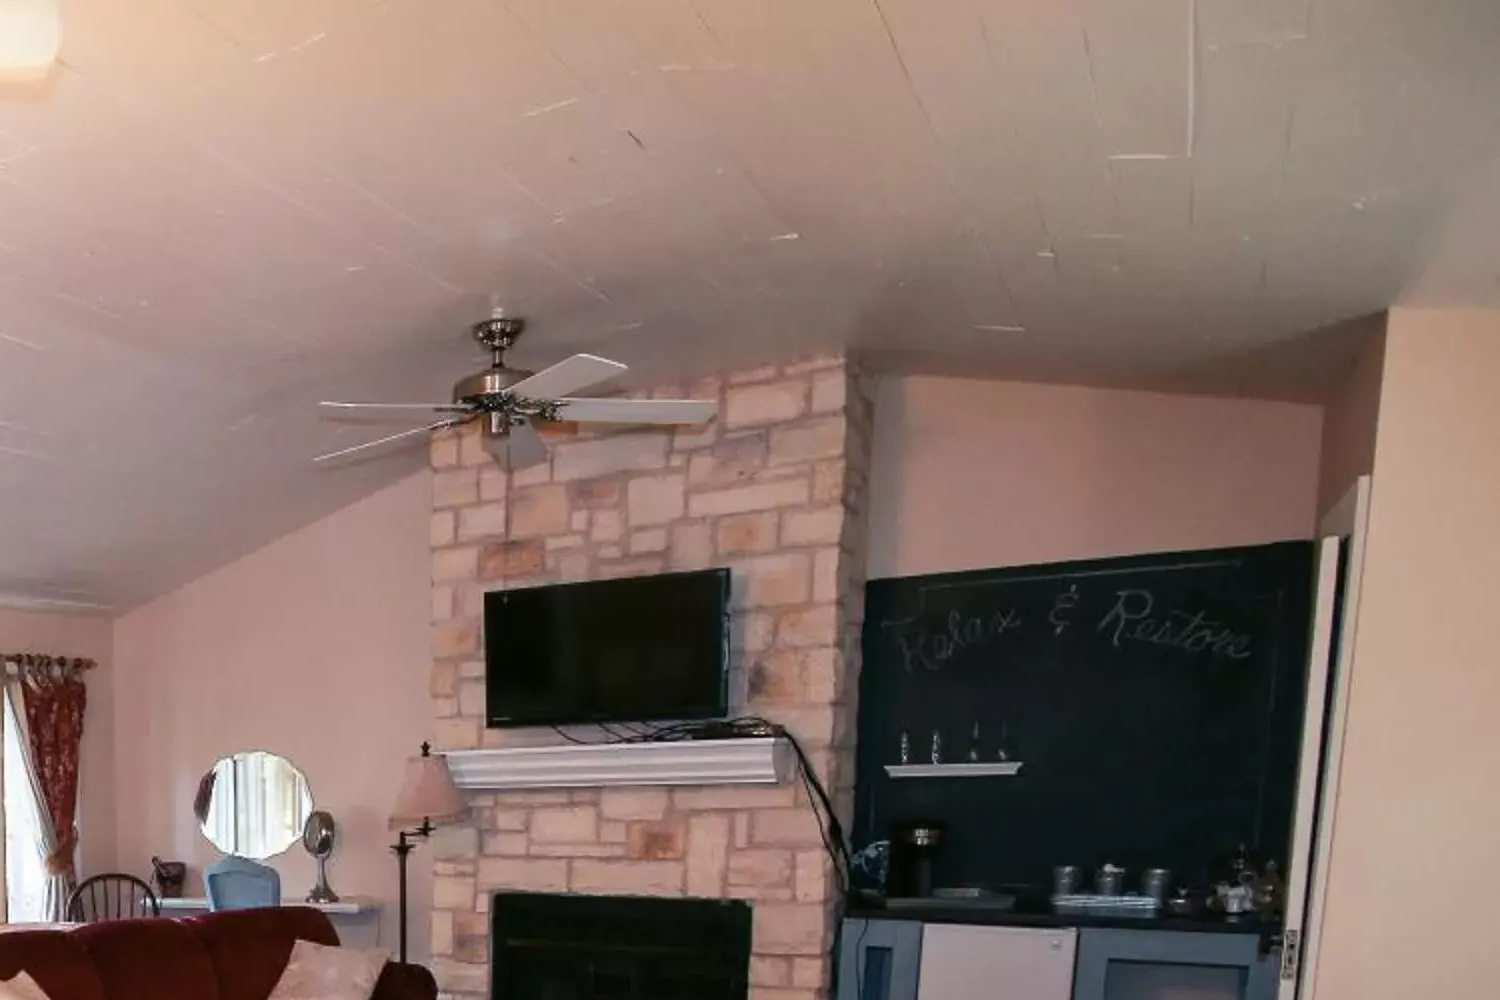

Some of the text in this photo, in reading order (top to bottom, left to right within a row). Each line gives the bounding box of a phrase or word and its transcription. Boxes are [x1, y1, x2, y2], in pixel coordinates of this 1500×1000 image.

[899, 584, 1252, 673] Relax & Restore
